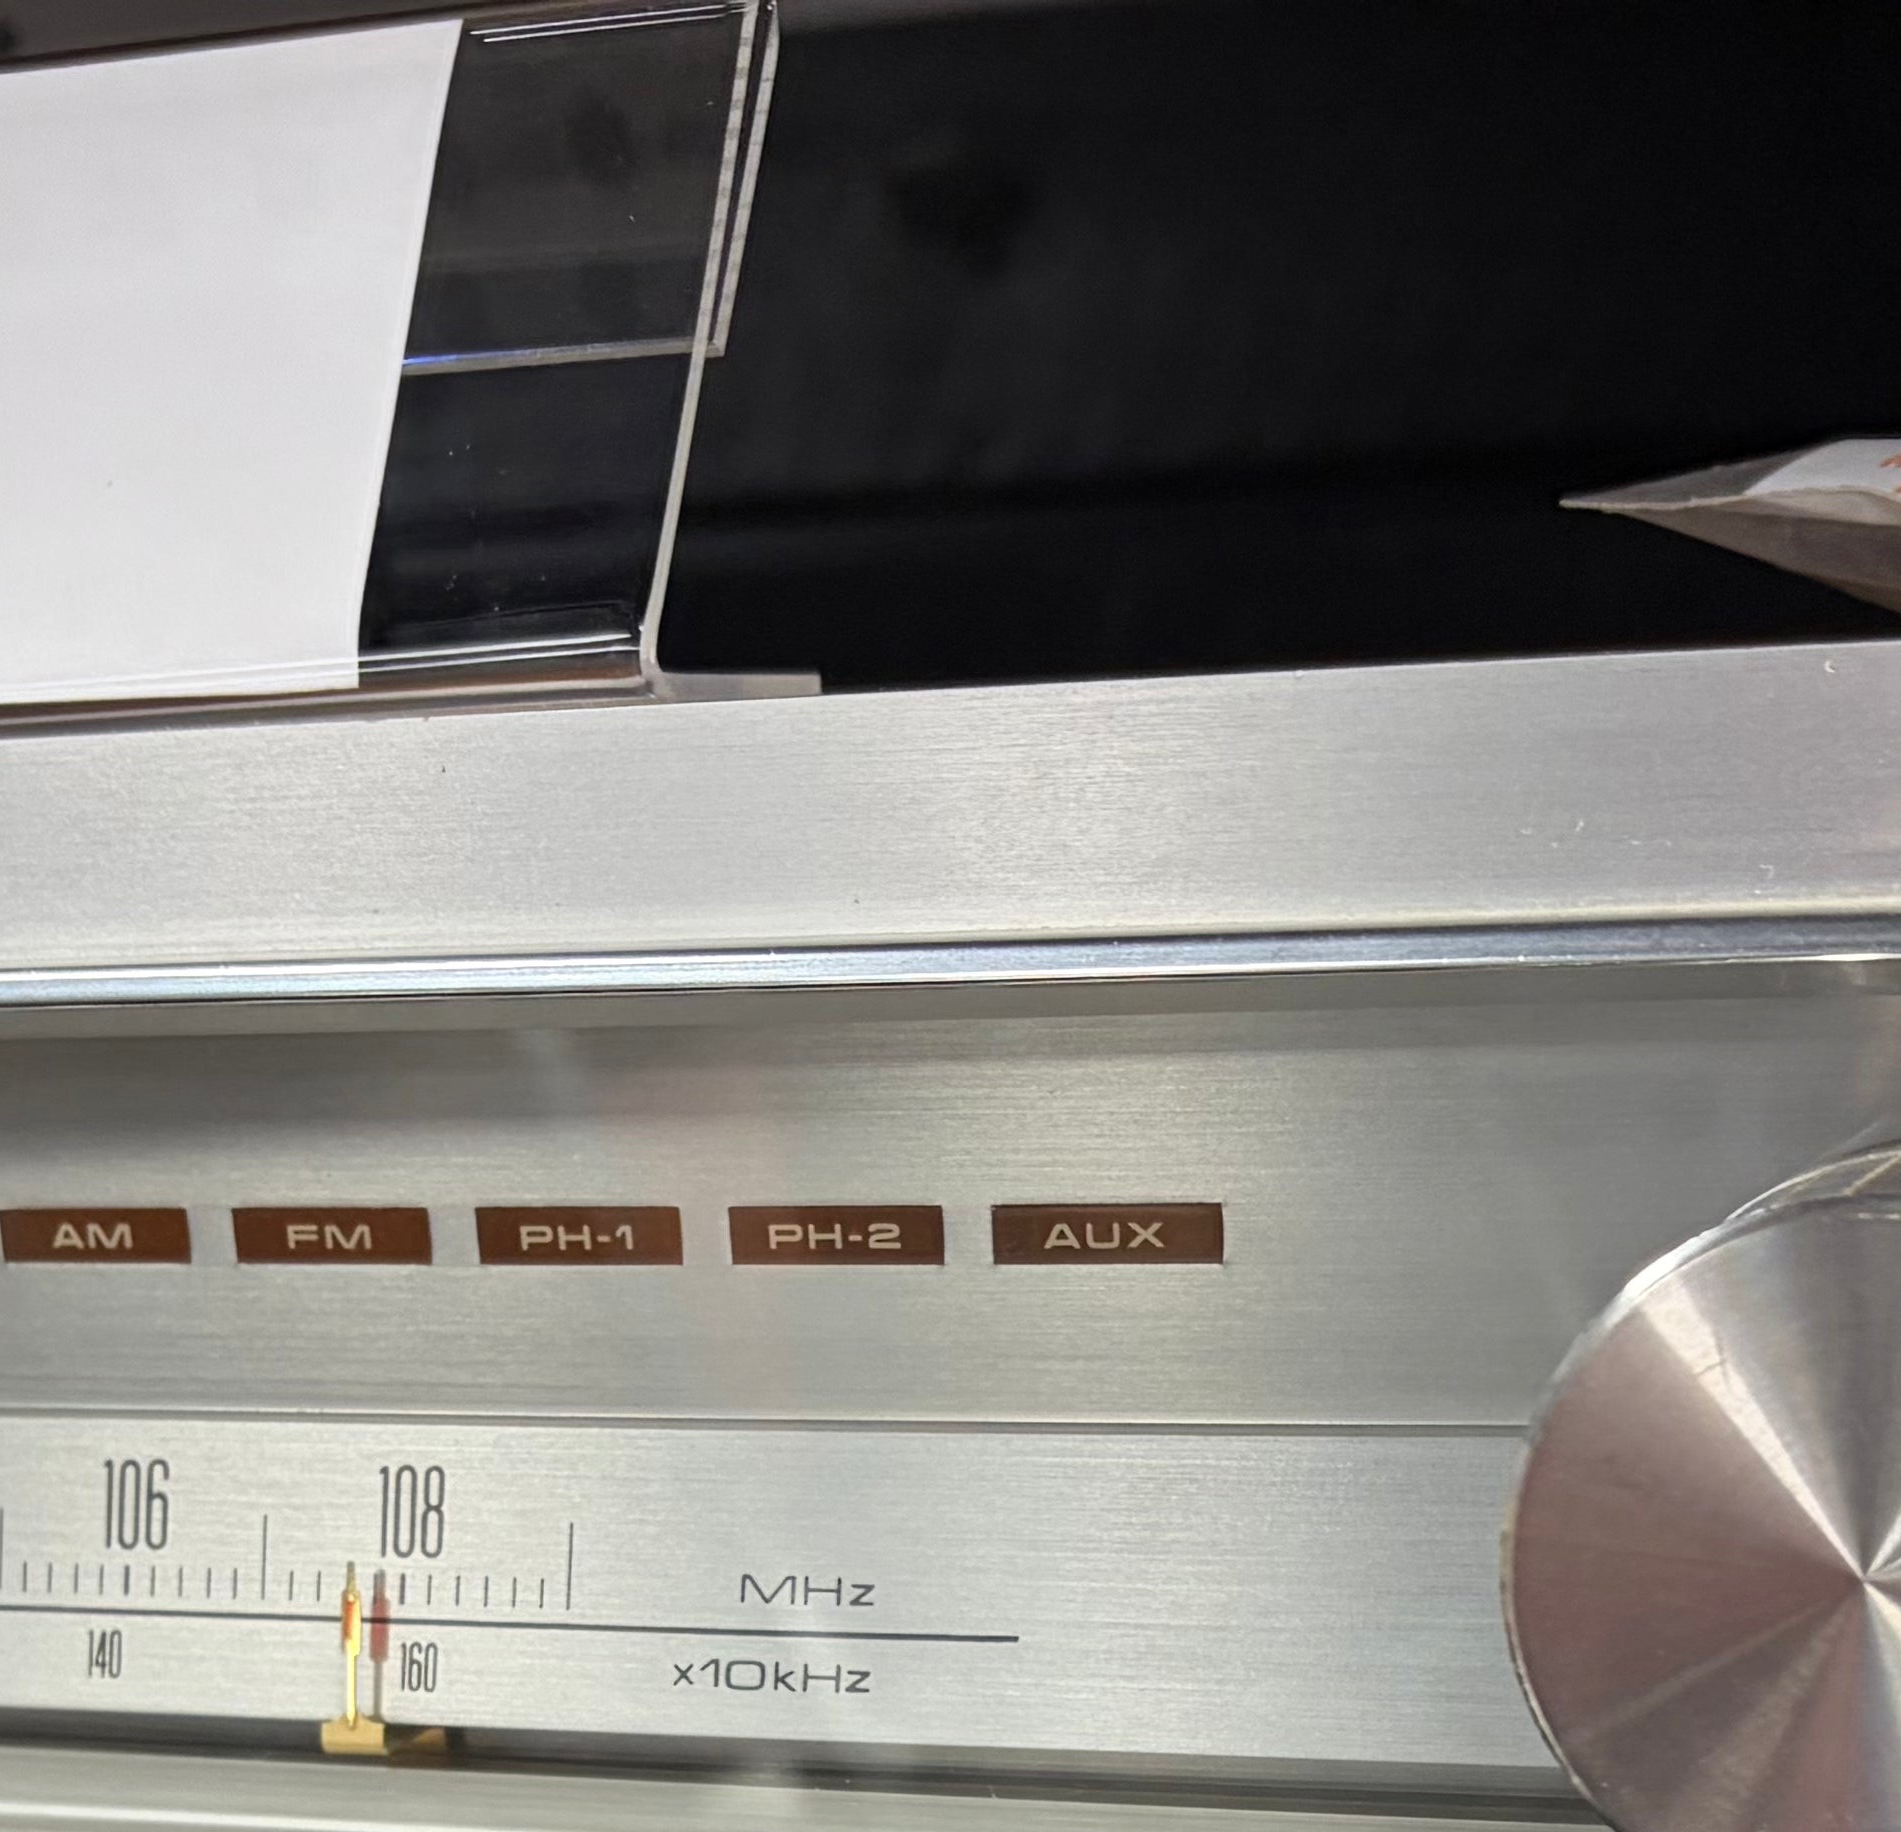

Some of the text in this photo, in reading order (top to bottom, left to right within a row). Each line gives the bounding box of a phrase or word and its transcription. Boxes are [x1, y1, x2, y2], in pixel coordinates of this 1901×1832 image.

[52, 1224, 133, 1250] AM
[287, 1224, 372, 1250] FM
[519, 1225, 634, 1251] PH-1
[768, 1224, 902, 1250] PH-2
[1043, 1222, 1164, 1250] AUX
[104, 1458, 170, 1550] 106
[378, 1464, 446, 1558] 108
[740, 1573, 875, 1607] MHz
[88, 1629, 123, 1680] 140
[400, 1642, 438, 1693] 160
[673, 1658, 872, 1694] x10kHz
